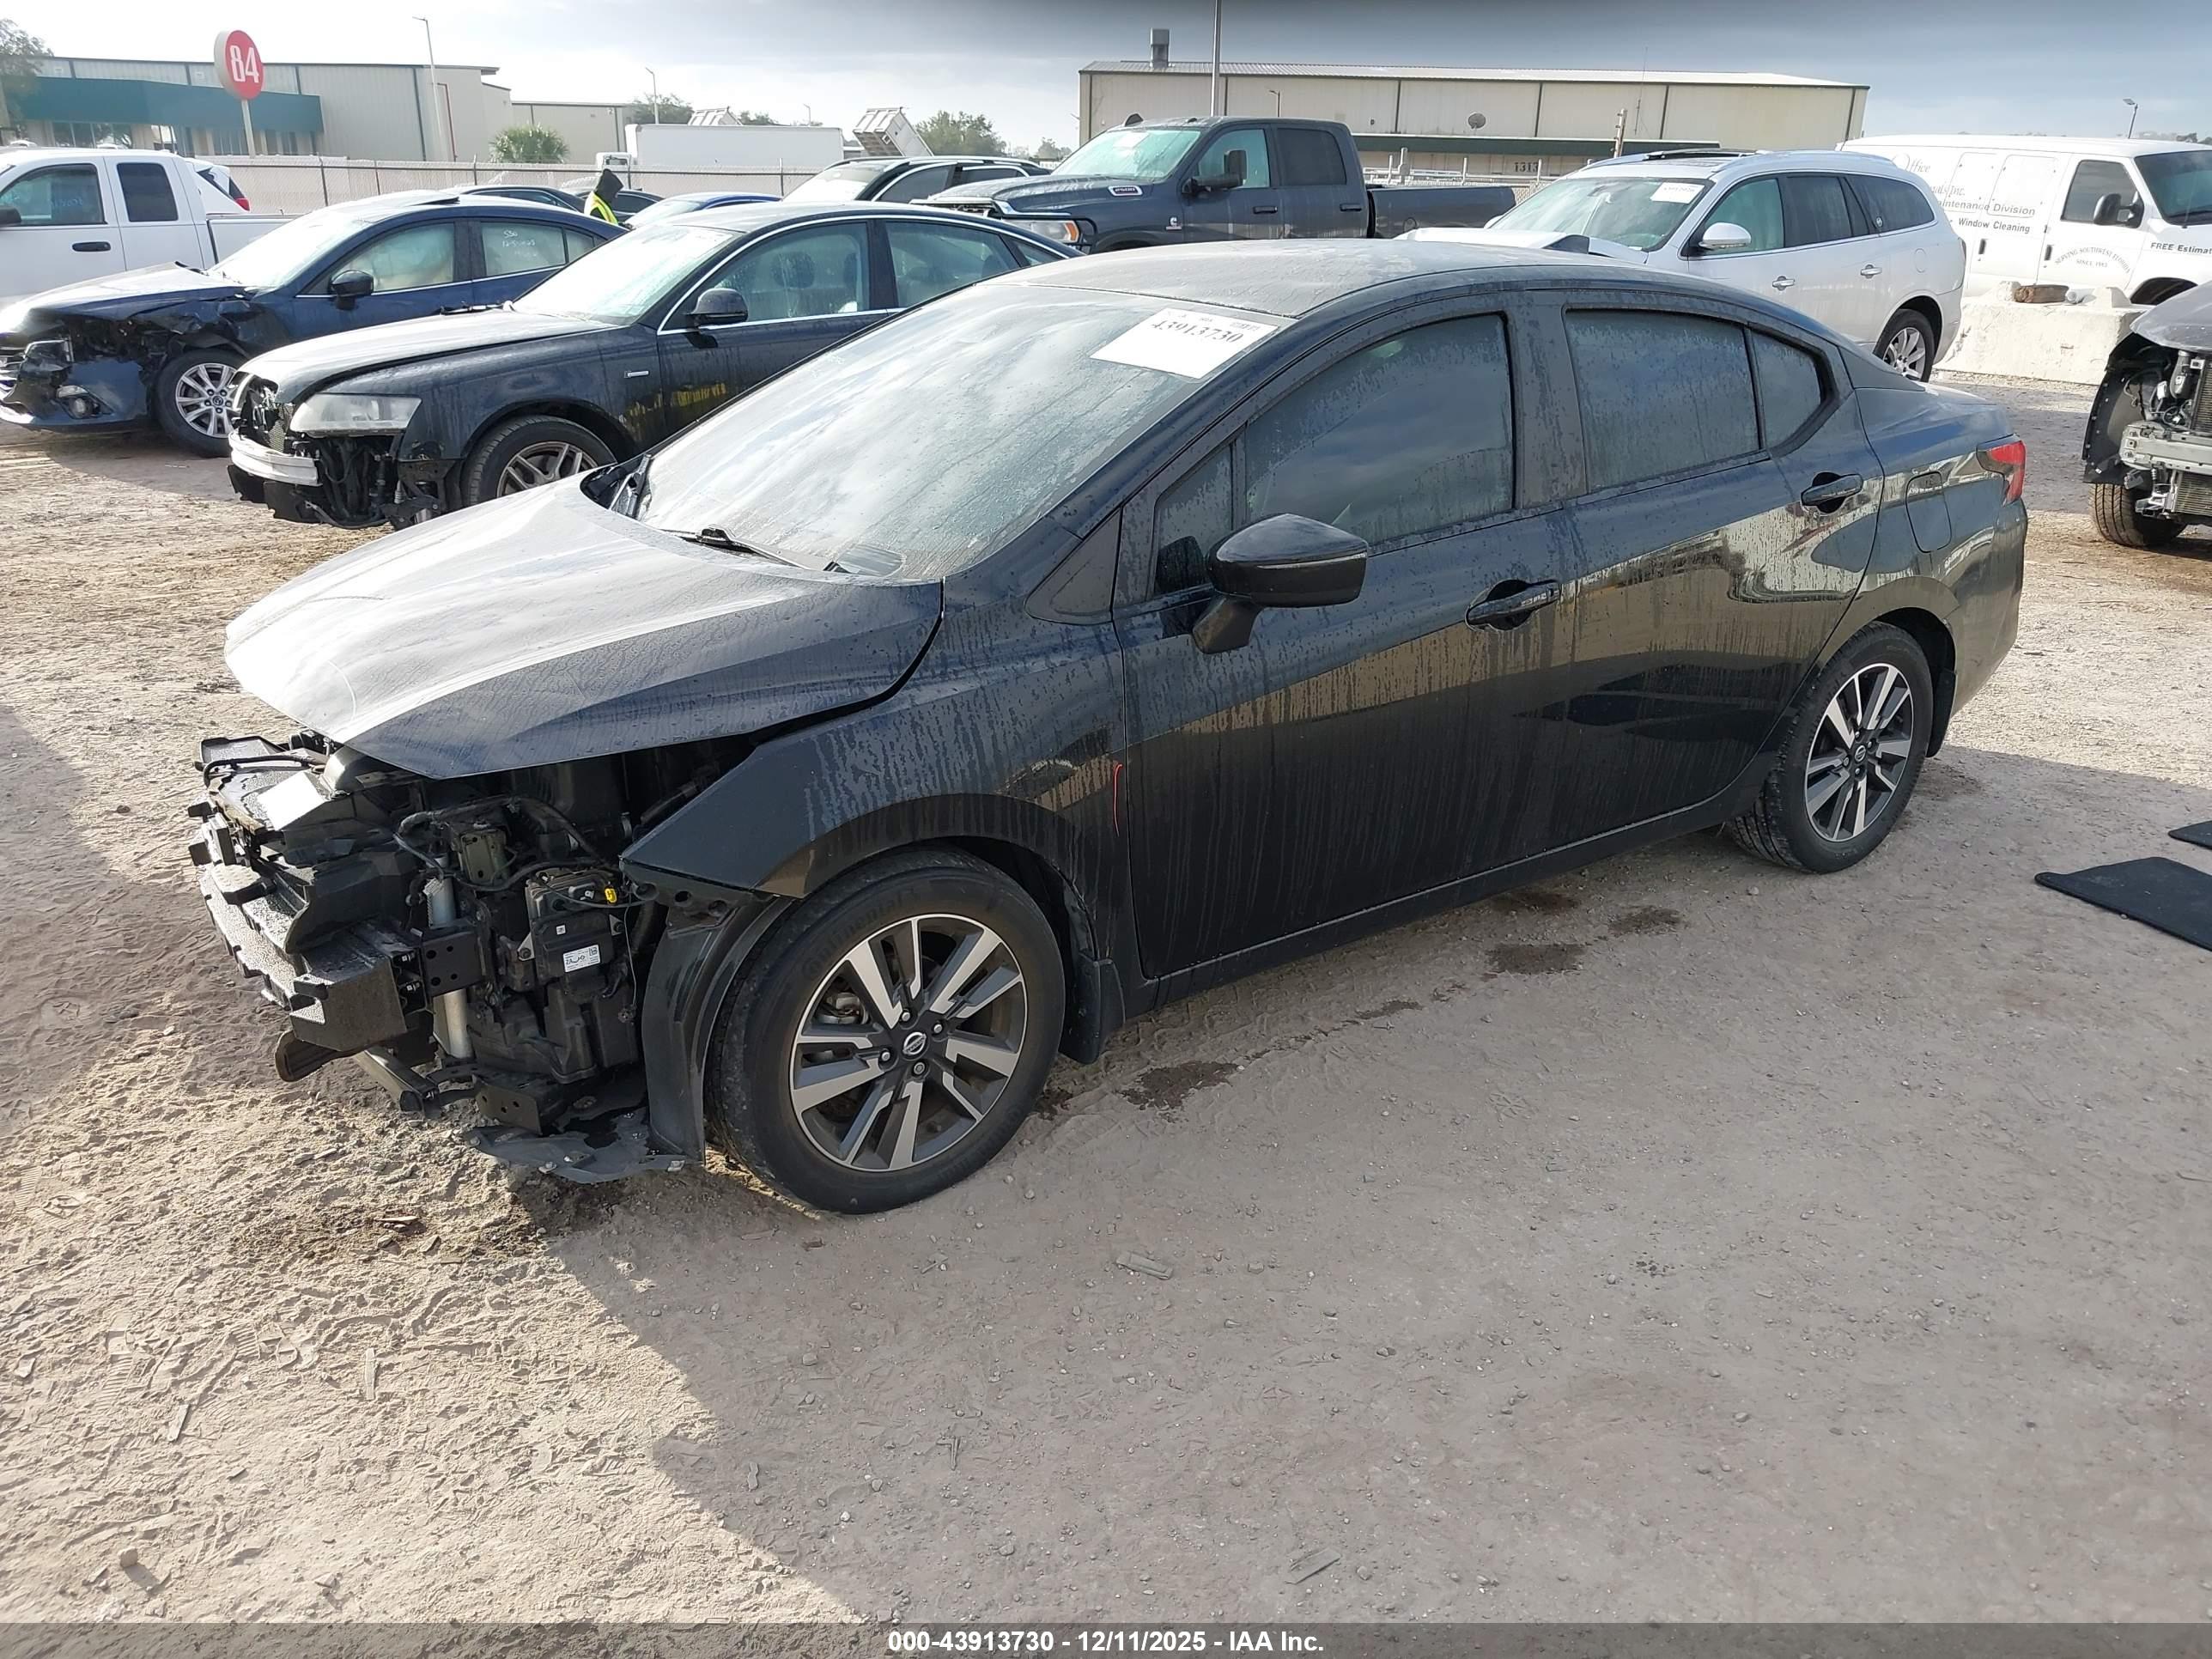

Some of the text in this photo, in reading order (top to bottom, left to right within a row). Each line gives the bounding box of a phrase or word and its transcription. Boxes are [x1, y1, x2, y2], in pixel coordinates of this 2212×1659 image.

[229, 45, 259, 83] 84
[1993, 204, 2036, 216] Division
[1958, 217, 2031, 234] Window Cleaning
[2079, 246, 2114, 258] SOUTHWEST
[2150, 242, 2174, 252] FREE
[1152, 320, 1244, 343] 43913730
